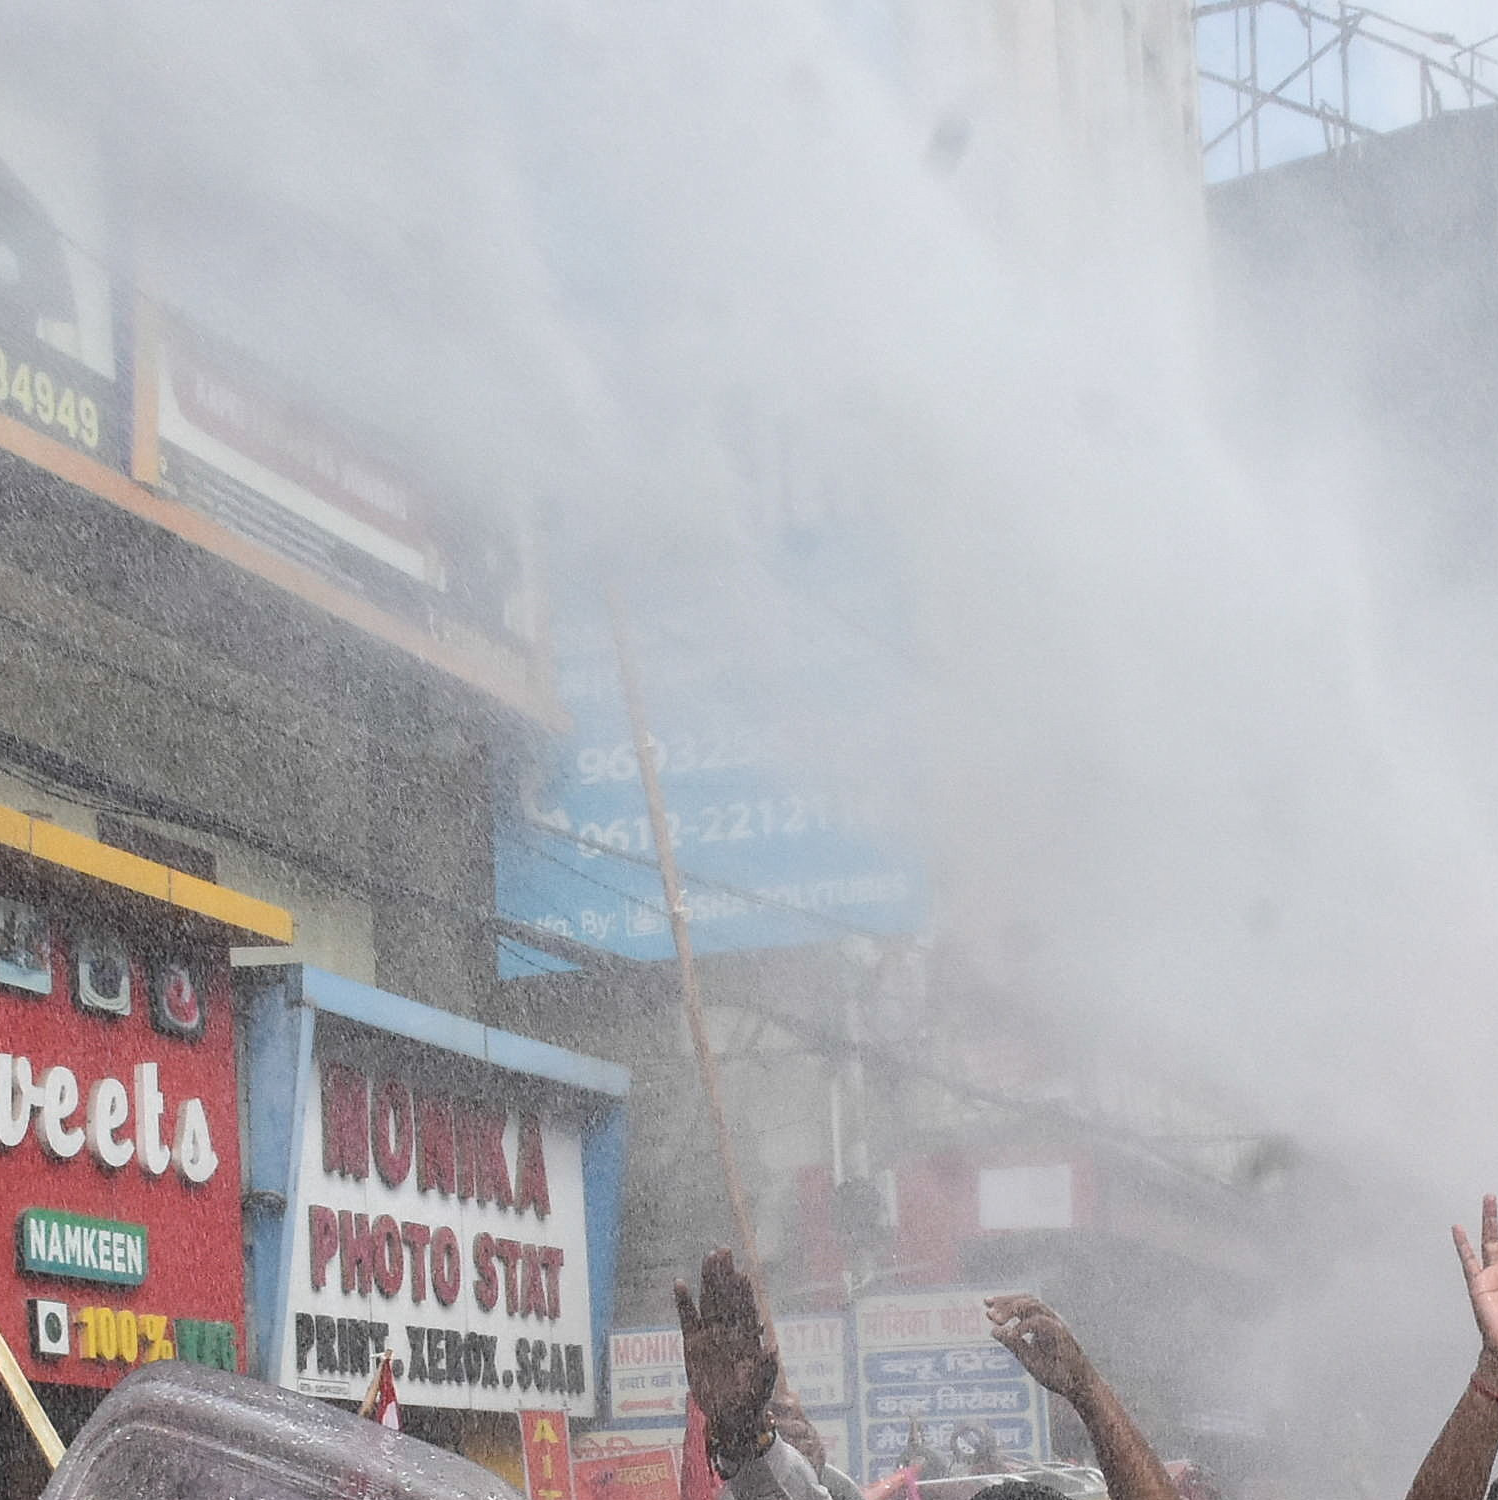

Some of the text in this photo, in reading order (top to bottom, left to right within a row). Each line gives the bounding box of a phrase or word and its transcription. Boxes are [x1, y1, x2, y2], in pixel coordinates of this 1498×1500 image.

[29, 1217, 144, 1277] NAMKEEN
[308, 1205, 565, 1321] PHOTO STAT
[76, 1307, 175, 1361] 100%
[614, 1333, 684, 1366] MONIK
